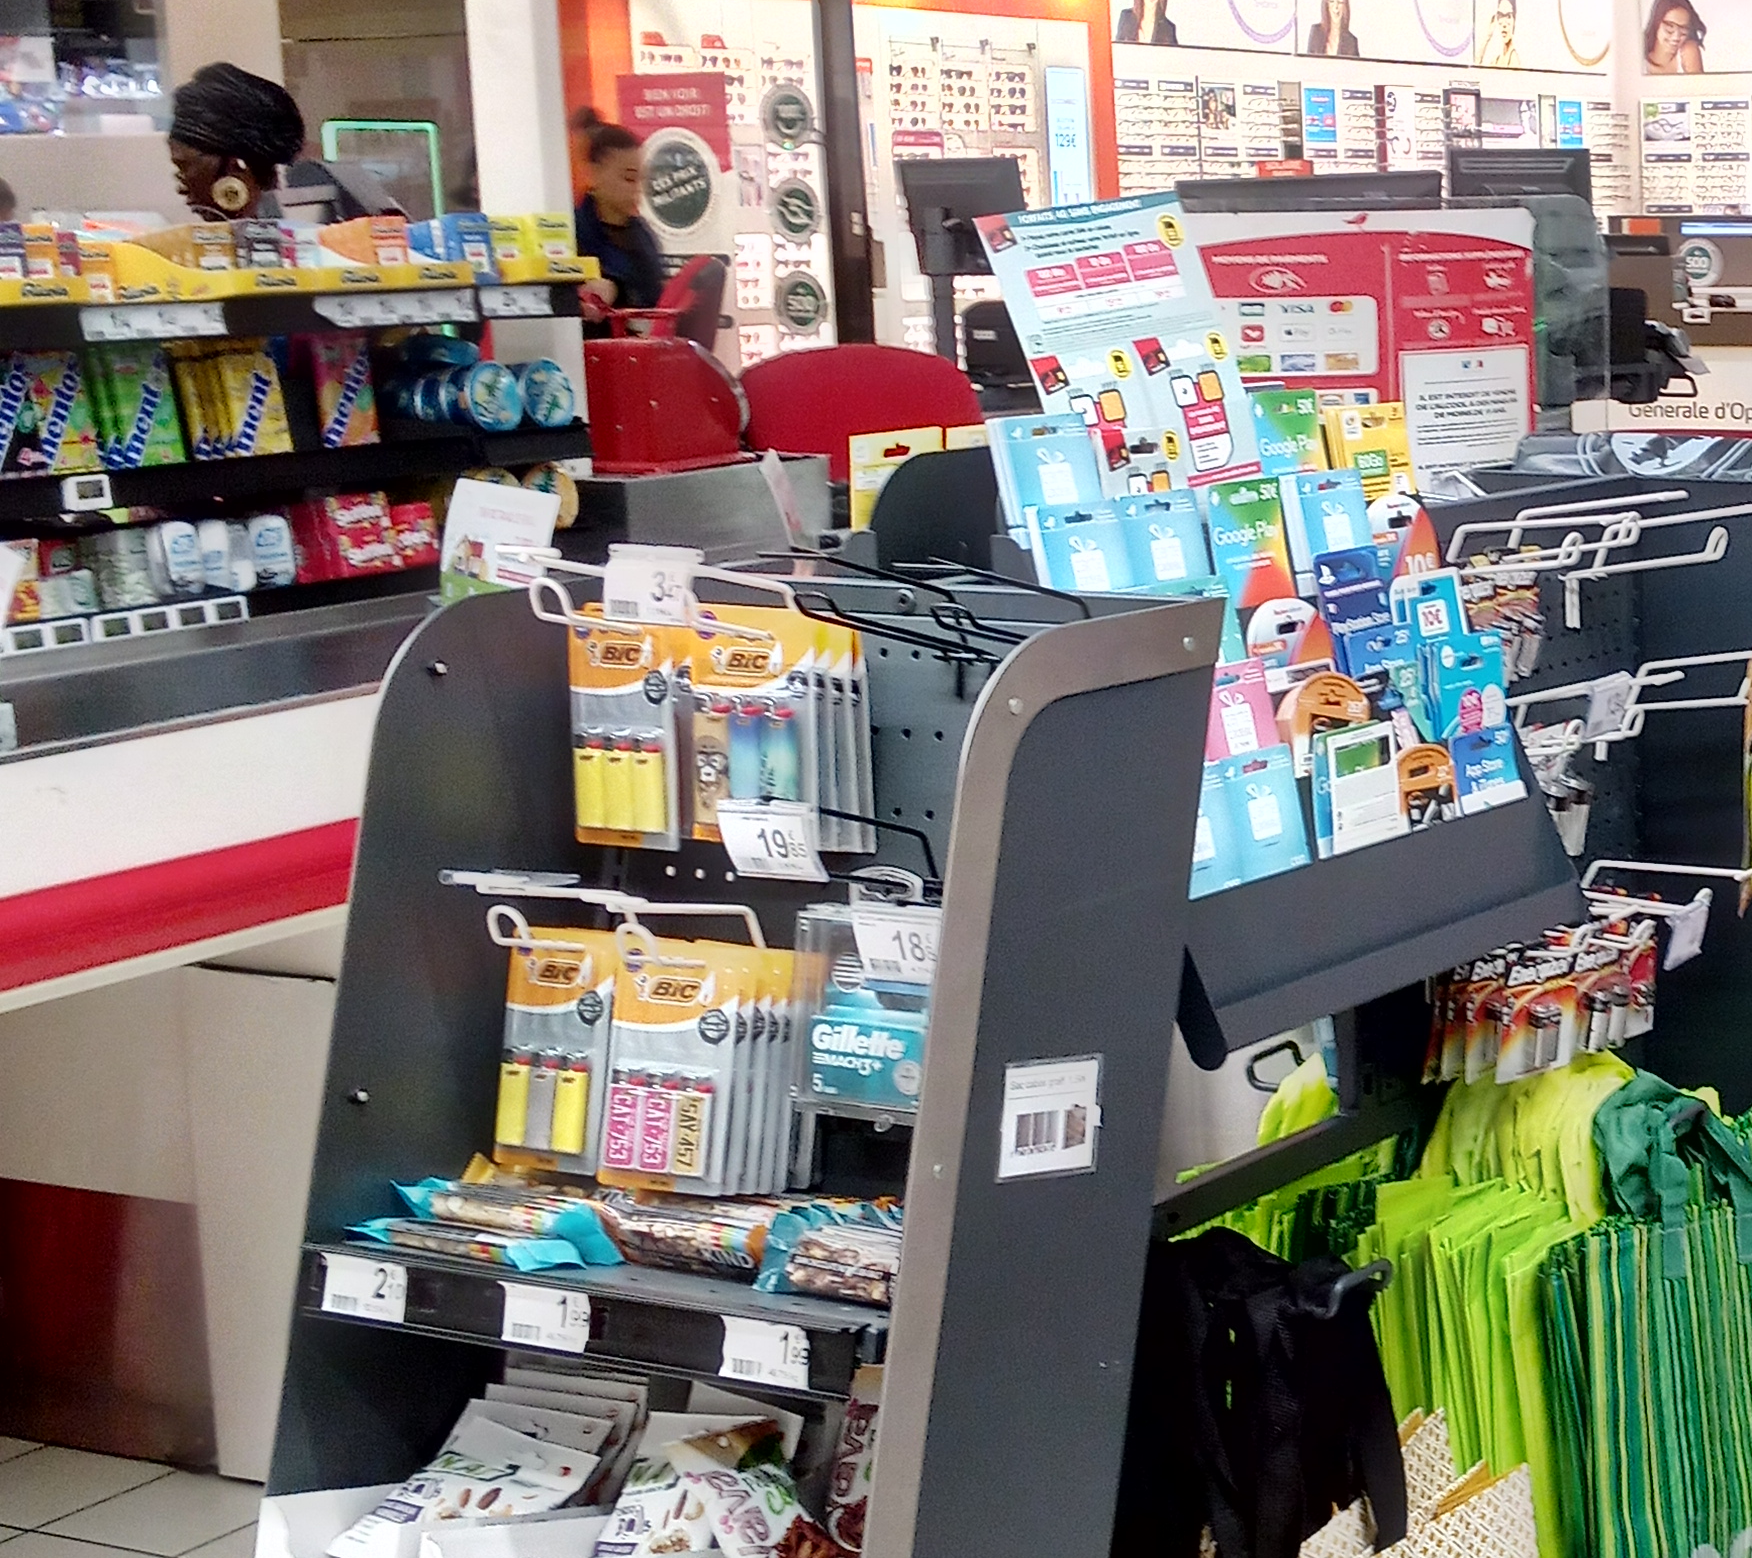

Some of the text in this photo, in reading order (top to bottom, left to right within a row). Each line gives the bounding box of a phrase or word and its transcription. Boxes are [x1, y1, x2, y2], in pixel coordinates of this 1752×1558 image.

[1629, 402, 1708, 420] Generale
[1260, 439, 1297, 458] Google
[600, 644, 641, 663] BIC
[726, 651, 769, 672] BIC
[537, 961, 580, 985] BIC
[648, 978, 701, 1003] BIC
[812, 1024, 906, 1060] Gillette
